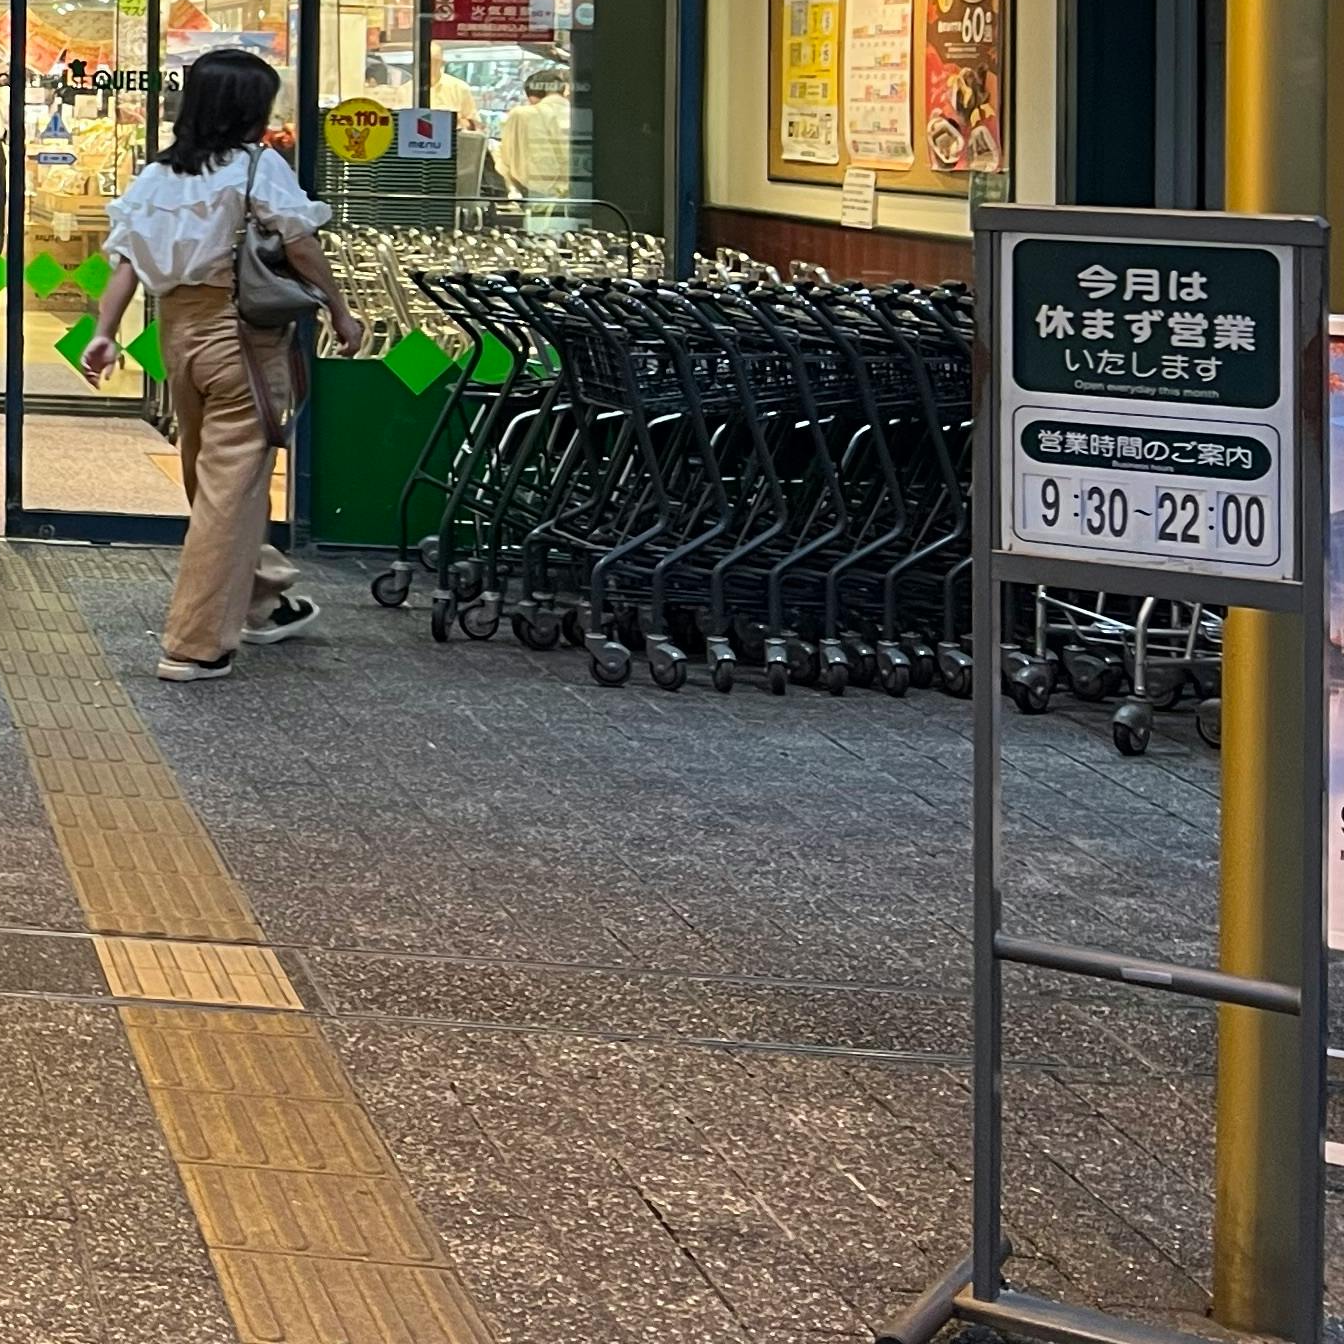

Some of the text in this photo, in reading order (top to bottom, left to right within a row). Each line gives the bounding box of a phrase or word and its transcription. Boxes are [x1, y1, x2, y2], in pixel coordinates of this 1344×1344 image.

[408, 141, 442, 150] menu
[1076, 264, 1208, 302] 今月は
[1034, 304, 1257, 352] 休まず営業
[1064, 348, 1224, 383] いたします
[1073, 378, 1220, 400] Open everyday this month
[1038, 428, 1253, 470] 営業時間のご案内
